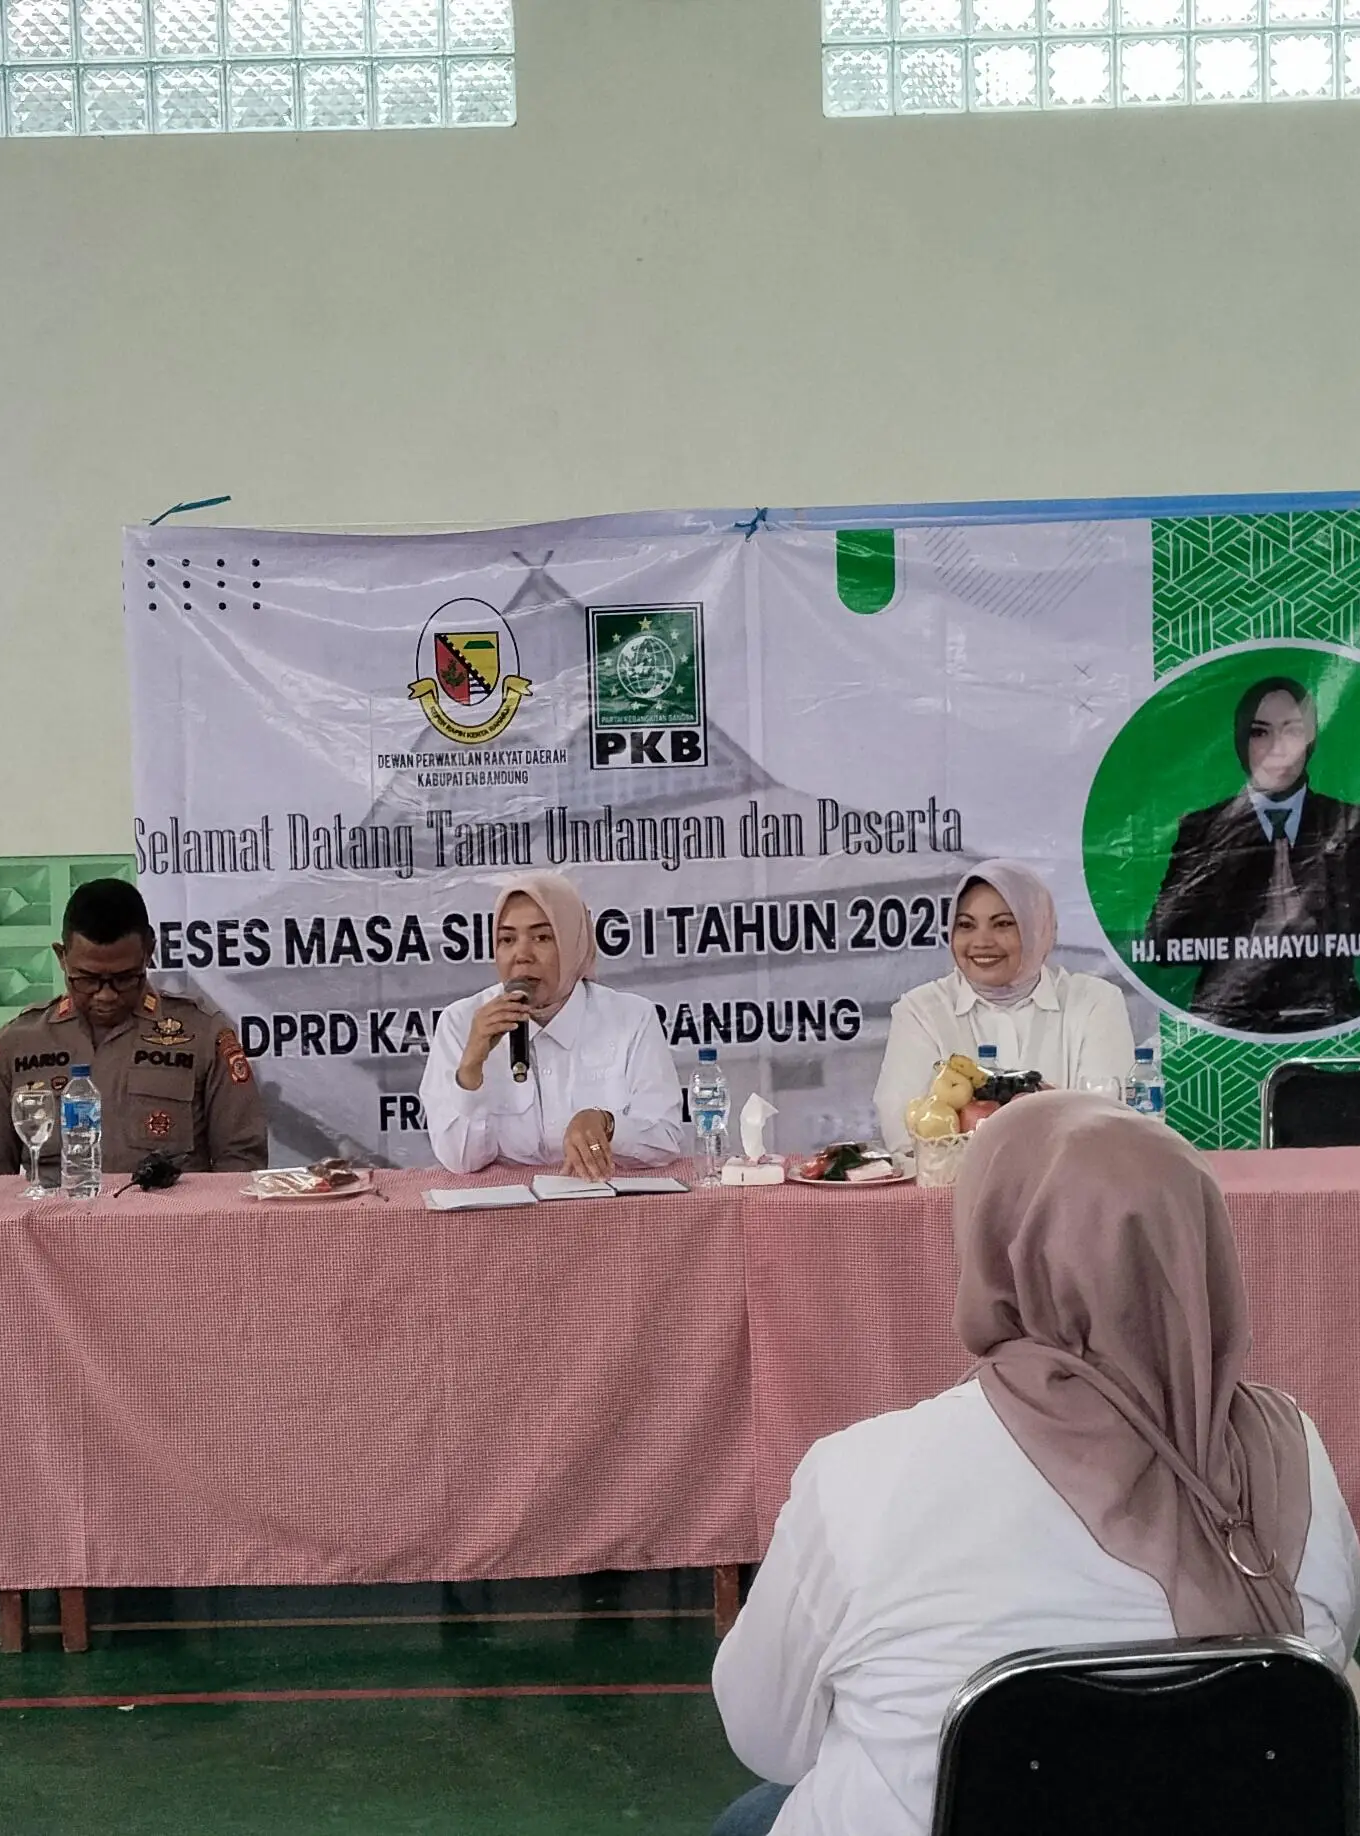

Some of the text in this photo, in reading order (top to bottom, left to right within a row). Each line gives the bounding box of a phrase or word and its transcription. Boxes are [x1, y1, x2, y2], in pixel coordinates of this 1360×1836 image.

[378, 750, 567, 768] DEWAN PERWAKILAN RAKYAT DAERAH
[596, 730, 701, 765] PKB
[134, 795, 963, 879] Selamat Datang Tamu Undangan dan Peserta
[148, 916, 271, 969] ESES
[285, 914, 431, 967] MASA
[644, 908, 653, 956] I
[667, 902, 836, 955] TAHUN
[1131, 939, 1161, 962] HJ.
[1167, 937, 1229, 961] RENIE
[1234, 934, 1318, 959] RAHAYU
[241, 1012, 359, 1057] DPRD
[134, 1050, 194, 1069] POLRI
